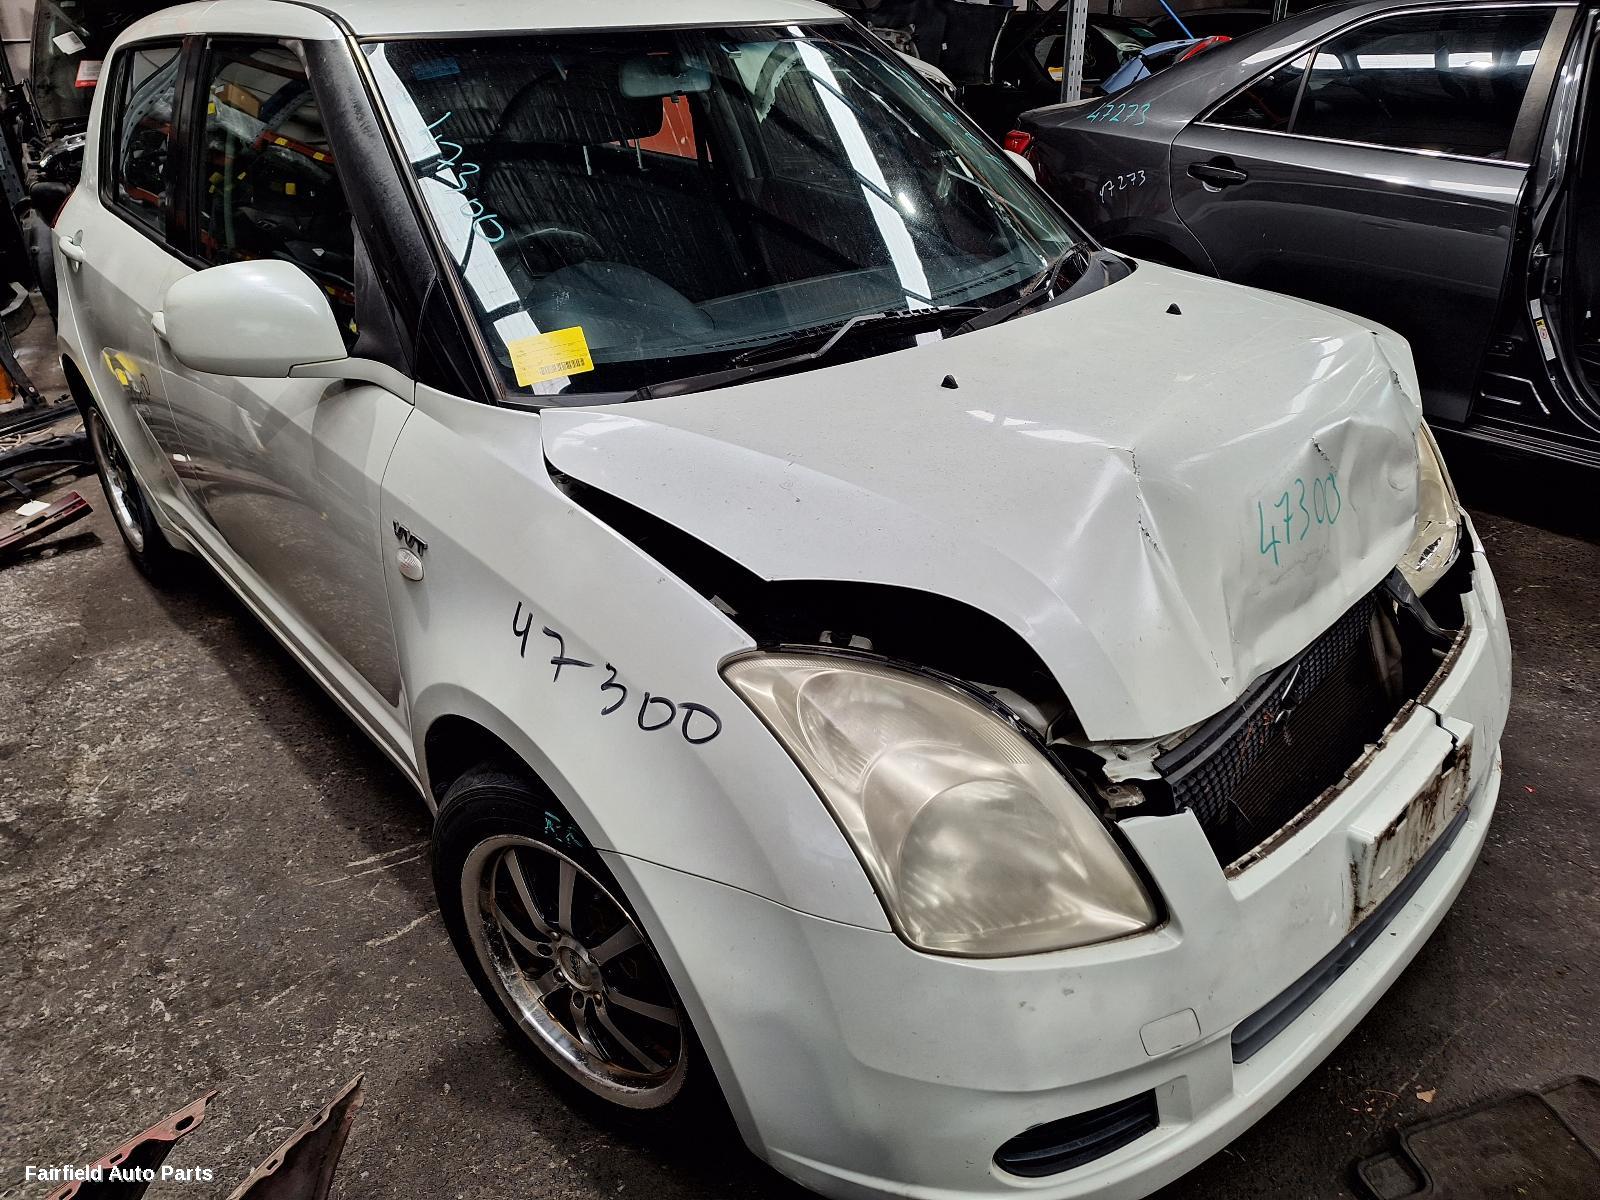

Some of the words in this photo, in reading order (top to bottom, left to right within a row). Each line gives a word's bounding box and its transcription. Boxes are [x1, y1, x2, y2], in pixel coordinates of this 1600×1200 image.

[1086, 102, 1151, 126] 47273
[1257, 472, 1342, 566] 47300
[512, 600, 723, 745] 47300
